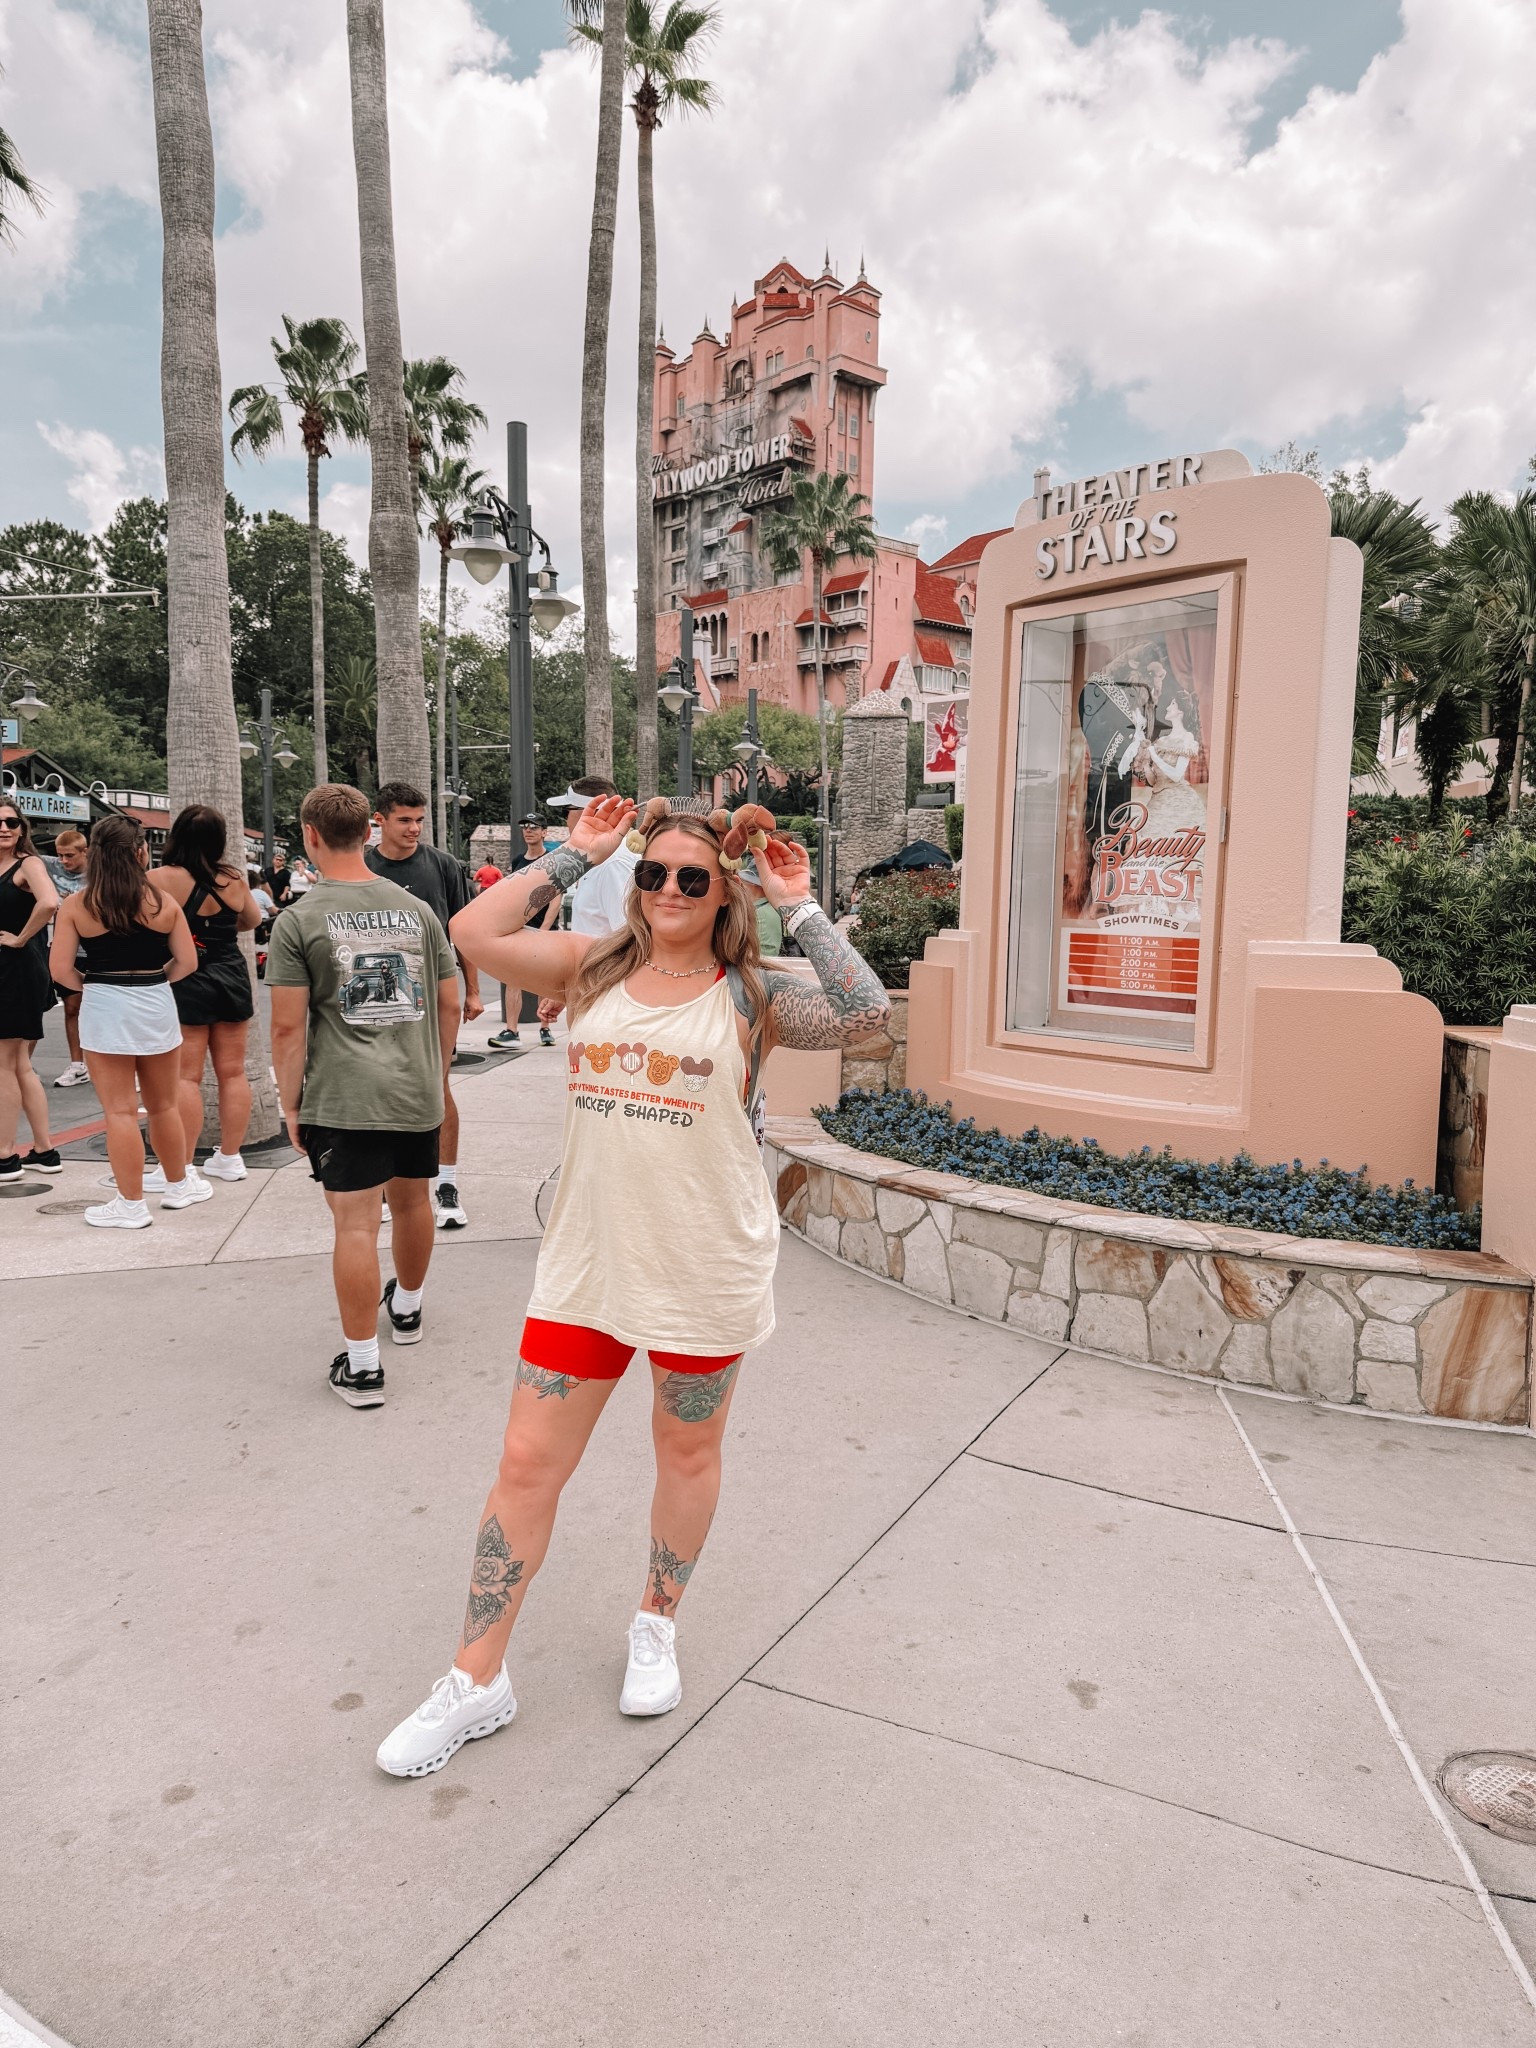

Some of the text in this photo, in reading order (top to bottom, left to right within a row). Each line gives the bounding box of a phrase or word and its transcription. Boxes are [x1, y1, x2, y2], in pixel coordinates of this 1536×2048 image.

[652, 432, 793, 501] LLYWOOD TOWER
[738, 466, 791, 507] Hotel
[1033, 454, 1202, 520] THEATER
[1069, 499, 1138, 531] OF THE
[1035, 510, 1177, 580] STARS
[47, 797, 71, 814] FARE
[1092, 801, 1206, 873] Beauty
[1122, 858, 1163, 868] and the
[1097, 852, 1202, 902] BEAST
[326, 910, 421, 932] MAGELLAN
[1104, 915, 1180, 930] SHOWTIMES
[331, 929, 422, 940] OUTDOORS
[1120, 937, 1143, 946] 11:00
[1123, 948, 1142, 957] 1:00
[1121, 959, 1141, 967] 2:00
[1120, 969, 1140, 978] 4:00
[1120, 980, 1140, 989] 5:00
[623, 1052, 640, 1070] MOM
[568, 1083, 705, 1112] EVYTHING TASTES BETTER WHEN IT'S
[623, 1103, 693, 1127] SHAPED
